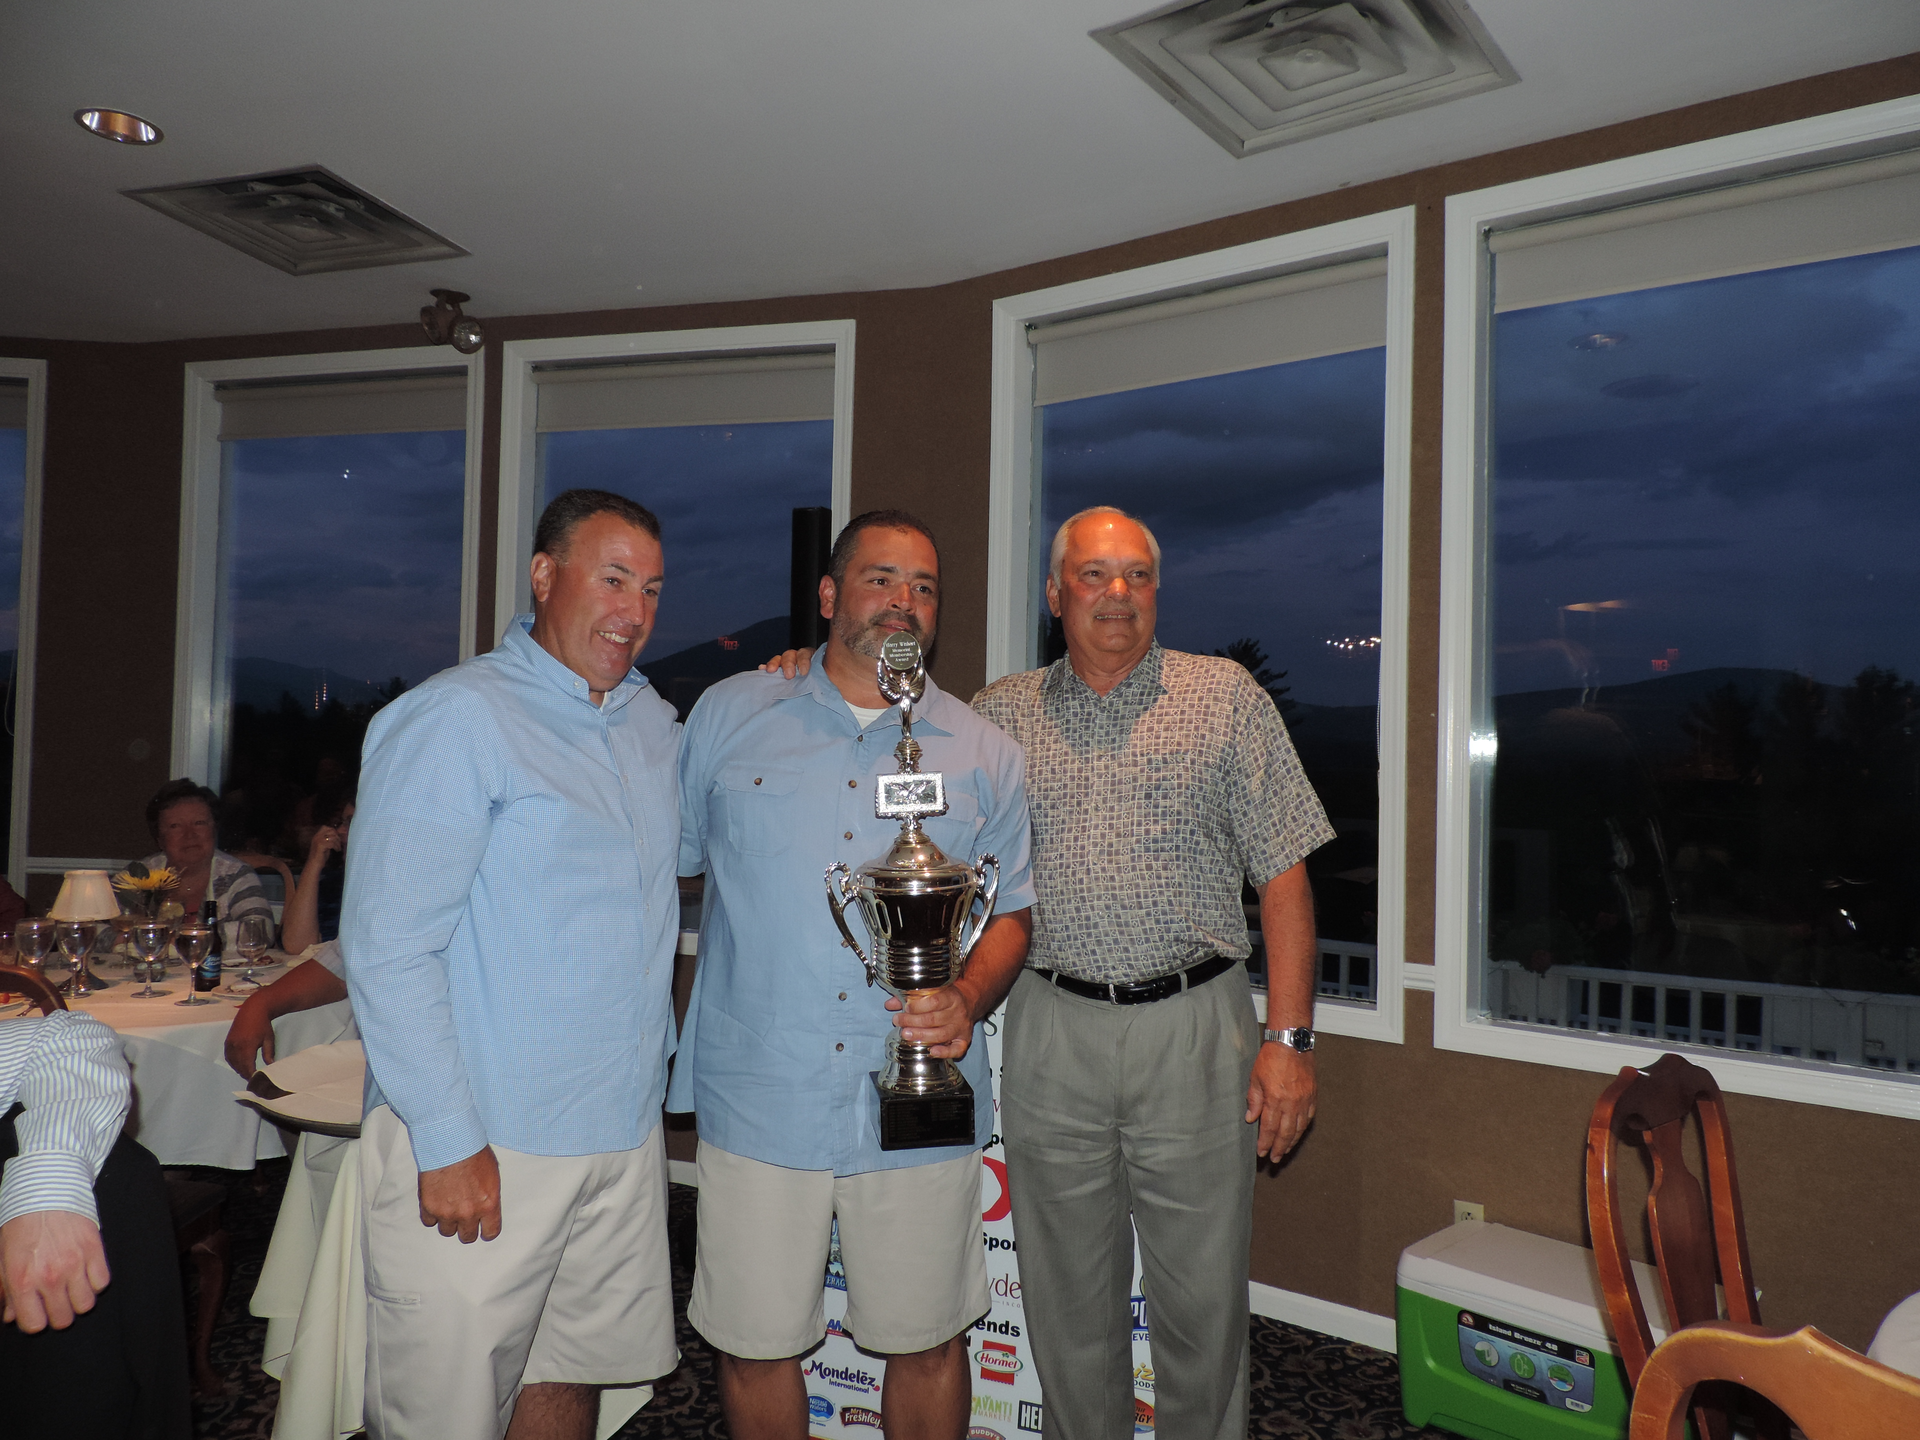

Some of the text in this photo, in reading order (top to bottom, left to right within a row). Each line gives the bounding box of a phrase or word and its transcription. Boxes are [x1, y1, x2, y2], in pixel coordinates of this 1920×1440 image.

[980, 1352, 1018, 1370] Hormel
[829, 1379, 870, 1394] International
[974, 1395, 1013, 1416] AVANTI
